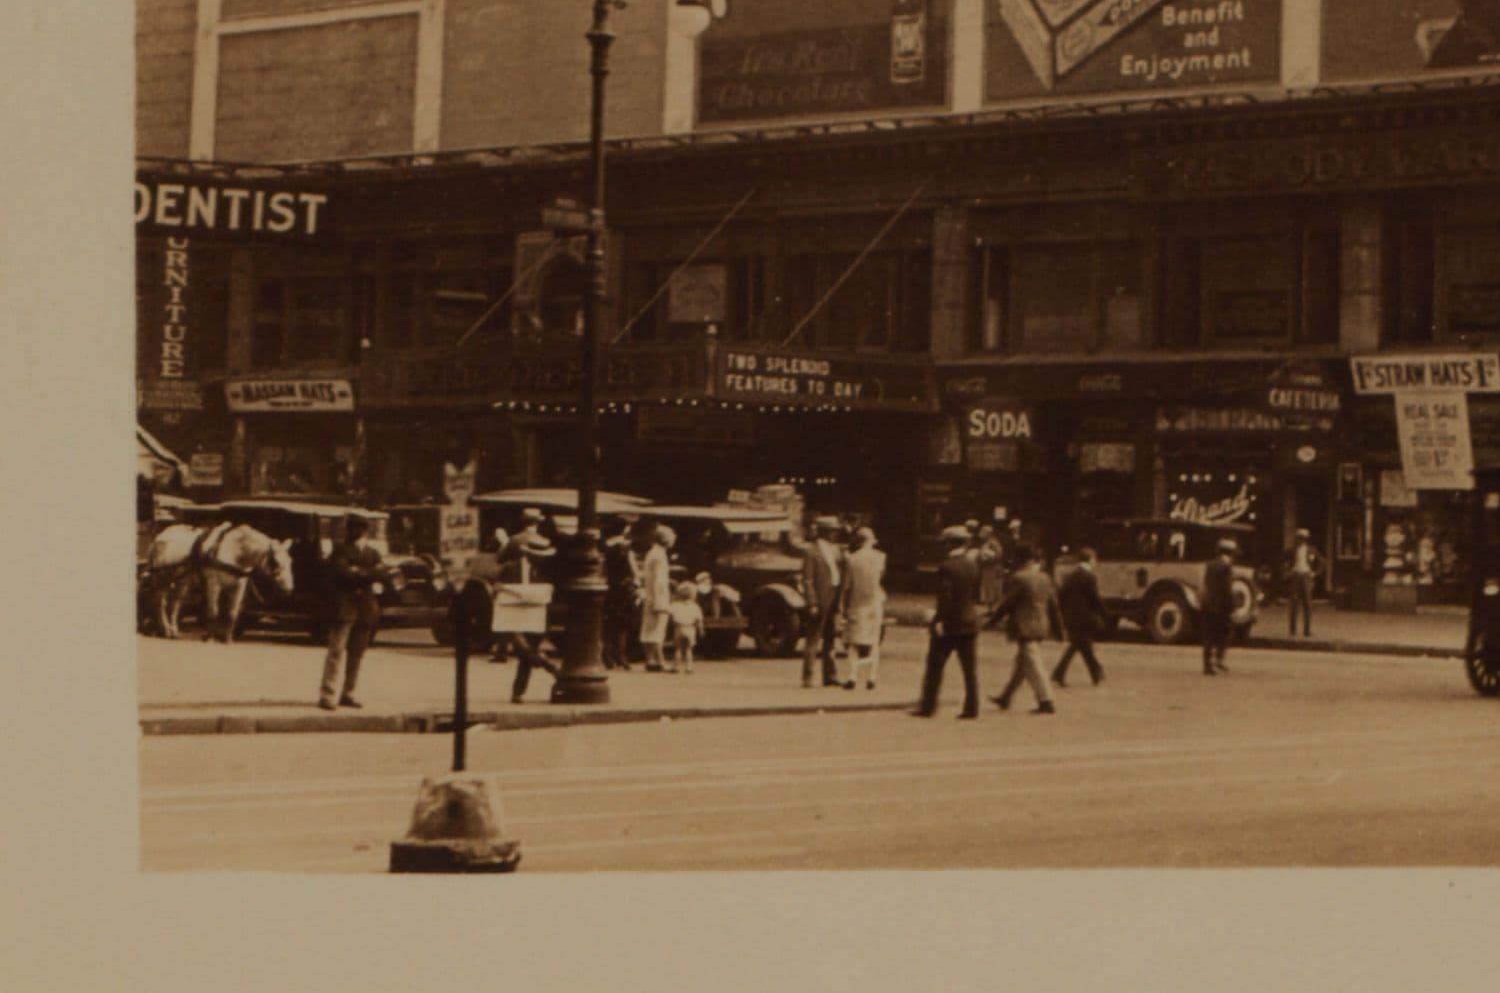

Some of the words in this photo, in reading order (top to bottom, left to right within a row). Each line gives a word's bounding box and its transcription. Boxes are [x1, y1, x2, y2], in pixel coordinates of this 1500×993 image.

[1162, 0, 1244, 26] Benefit
[1183, 24, 1219, 48] and
[1119, 49, 1252, 80] Enjoyment
[136, 181, 327, 235] DENTIST
[727, 353, 757, 371] TWO
[1374, 362, 1427, 388] STRAW
[1431, 360, 1473, 386] HATS
[726, 374, 798, 394] FEATURES
[807, 379, 826, 396] TO
[833, 380, 863, 398] DAY
[1268, 388, 1341, 411] CAFETERIA
[968, 409, 1032, 438] SODA
